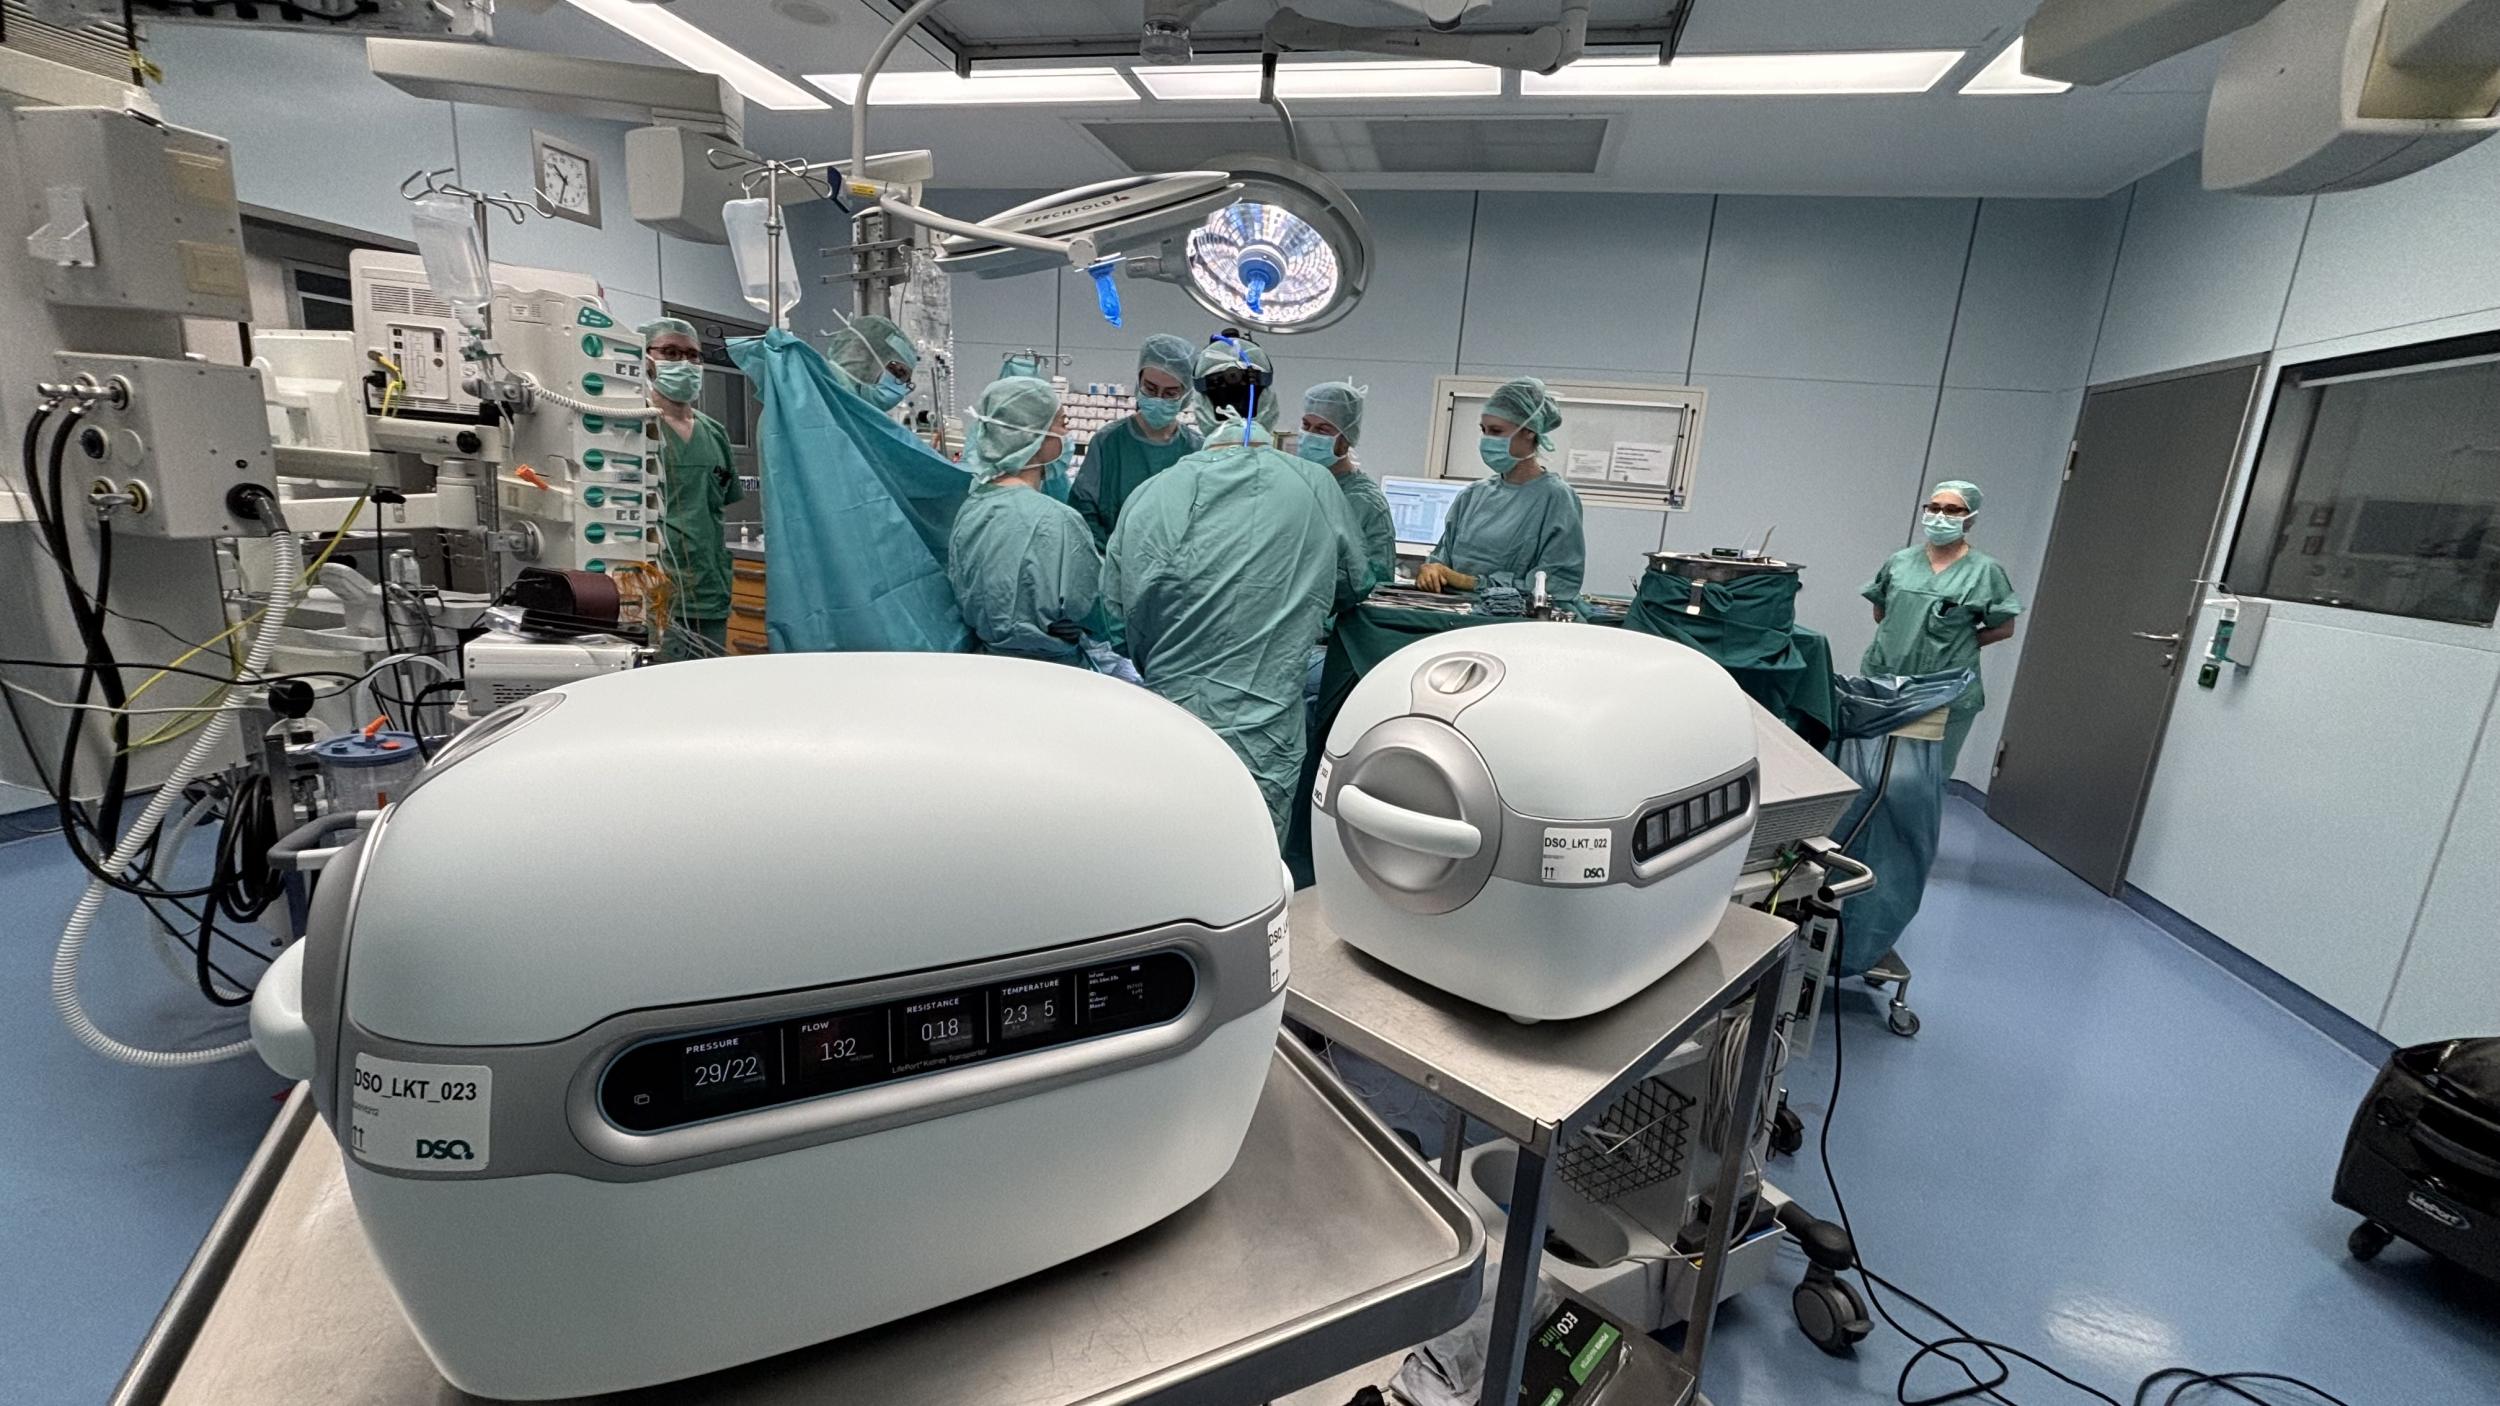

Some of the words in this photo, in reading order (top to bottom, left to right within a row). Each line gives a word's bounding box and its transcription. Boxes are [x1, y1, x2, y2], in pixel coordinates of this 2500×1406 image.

[1544, 837, 1608, 851] DSO_LKT_022
[1002, 979, 1060, 996] TEMPERATURE
[906, 997, 960, 1014] RESISTANCE
[1004, 1004, 1028, 1025] 2.3
[1044, 999, 1054, 1017] 5
[801, 1021, 830, 1033] FLOW
[921, 1018, 959, 1041] 0.18
[685, 1037, 740, 1054] PRESSURE
[820, 1037, 857, 1062] 132
[694, 1056, 758, 1087] 29/22
[354, 1068, 477, 1103] DSO_LKT_023
